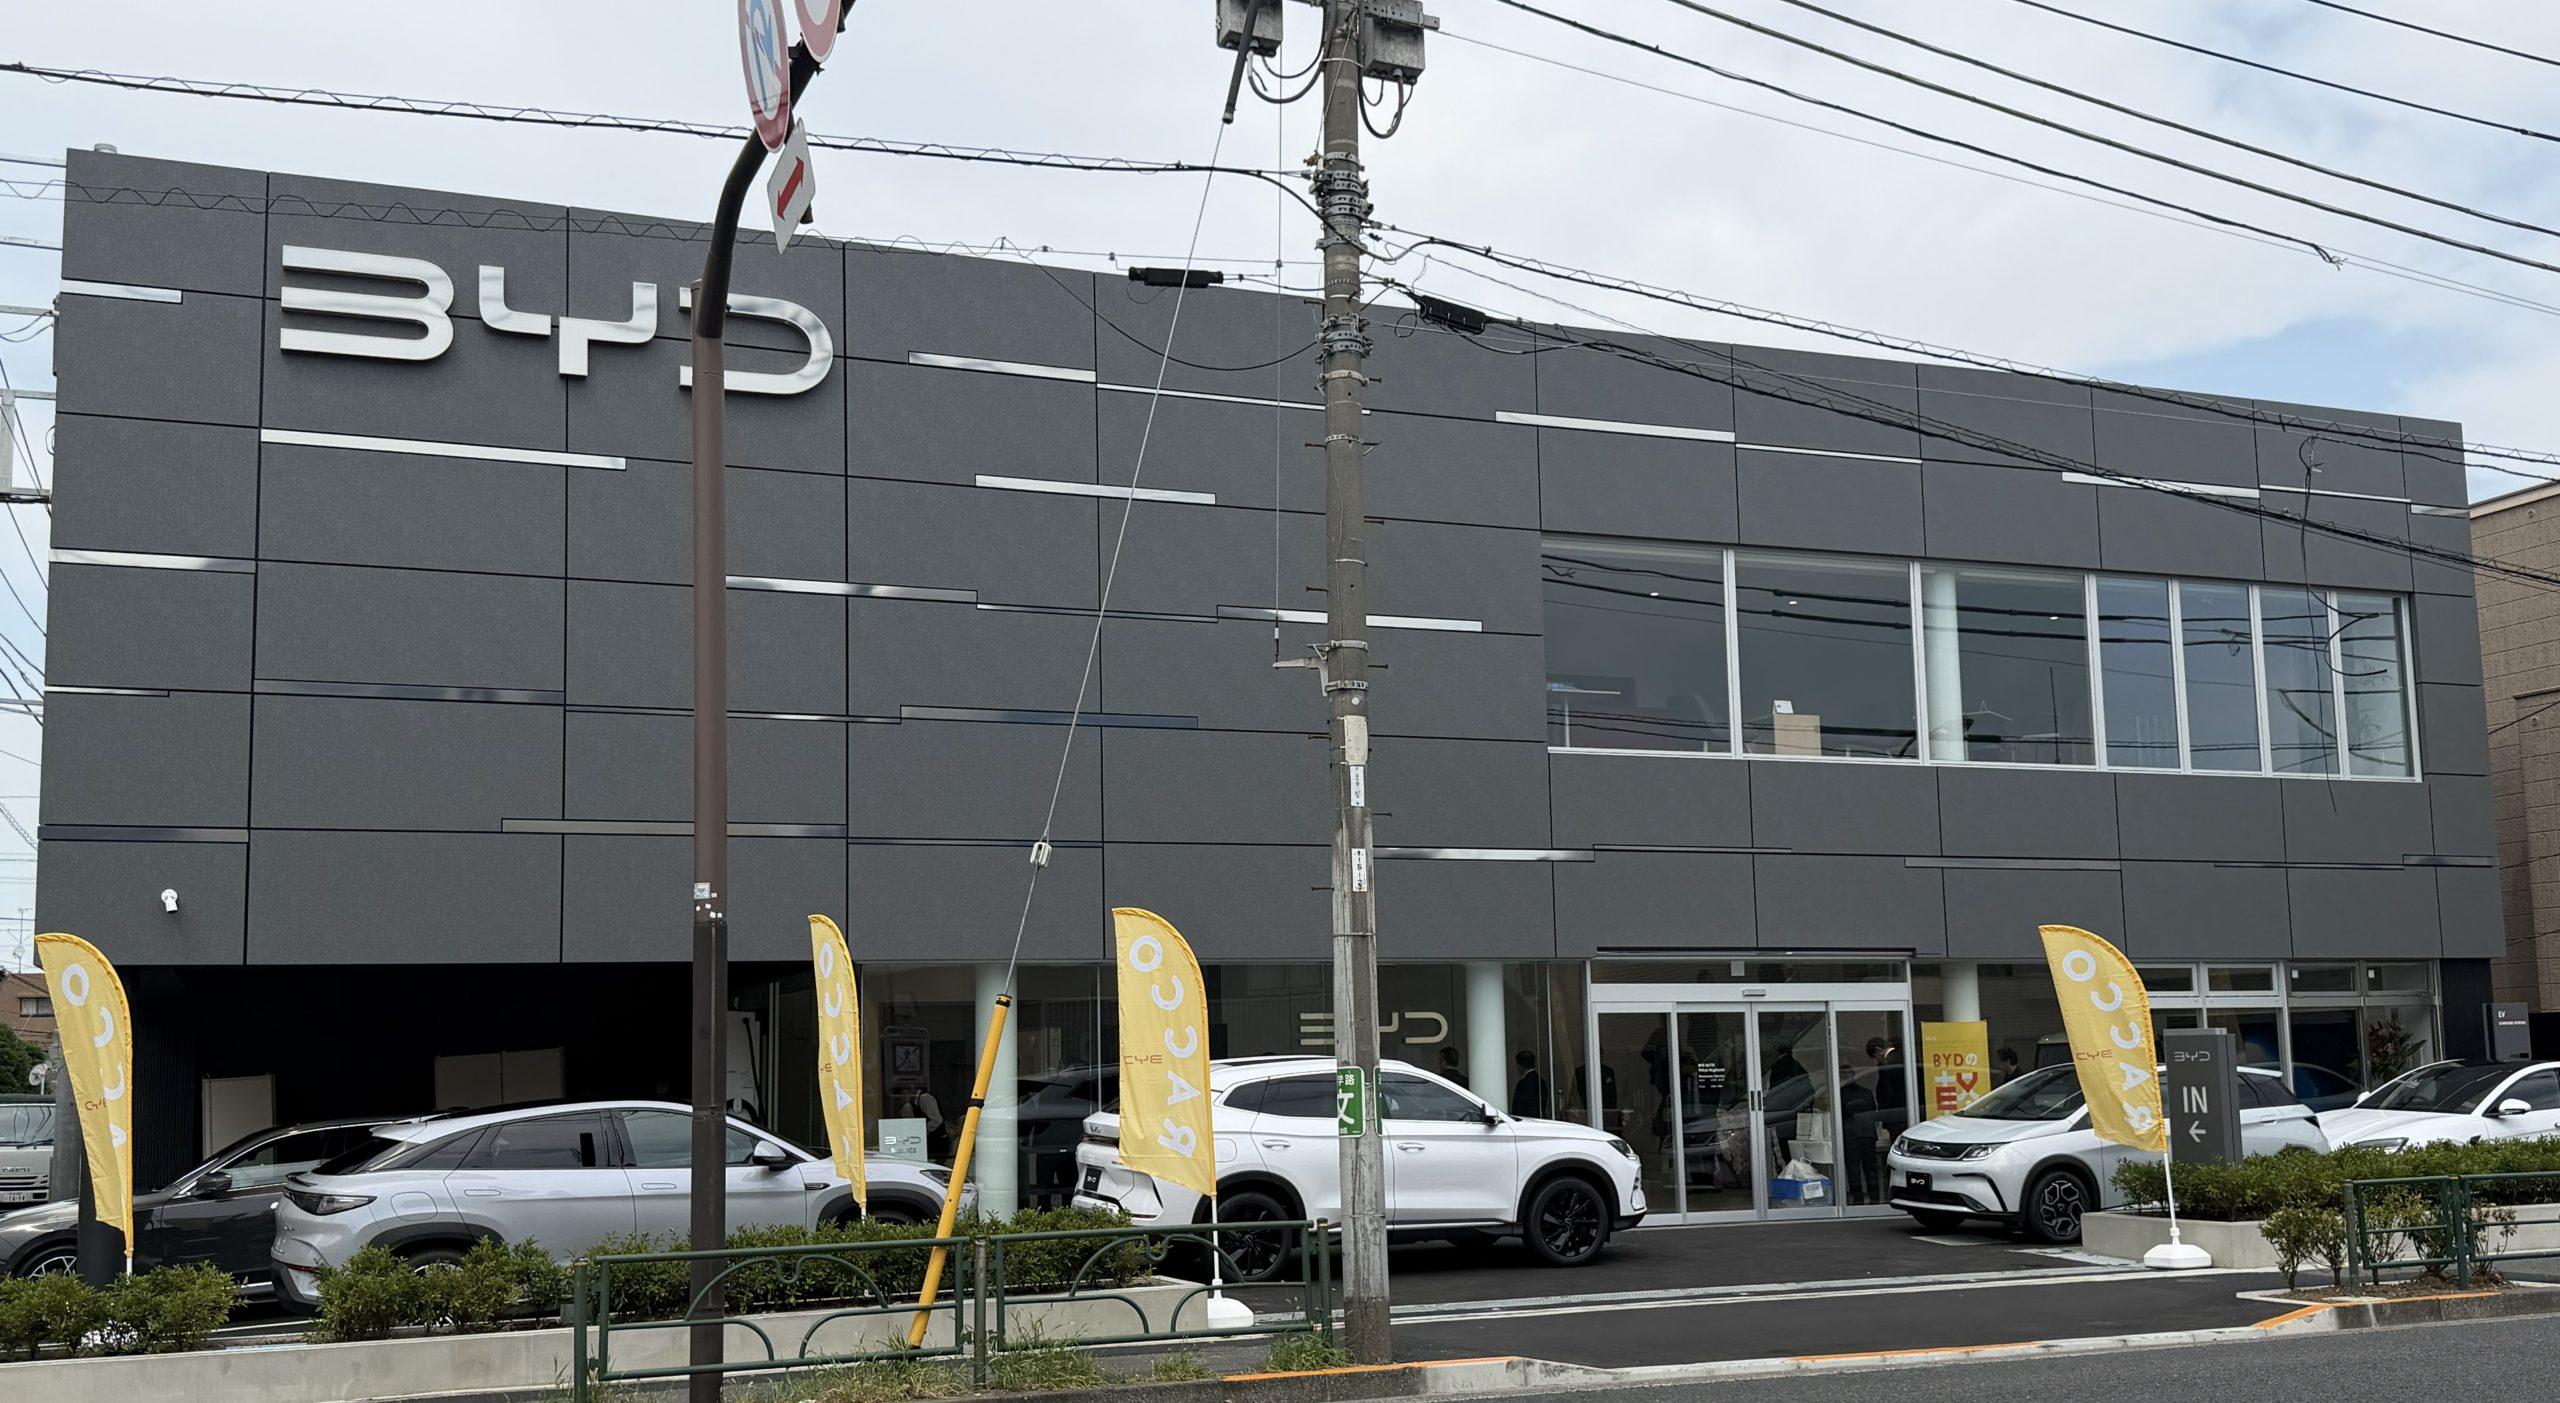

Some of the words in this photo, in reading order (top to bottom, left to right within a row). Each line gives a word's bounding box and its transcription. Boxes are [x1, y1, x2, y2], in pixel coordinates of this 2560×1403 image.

[280, 244, 834, 395] BYD
[1933, 1053, 1977, 1068] BYDの
[2173, 1051, 2211, 1062] BYD
[1337, 1088, 1355, 1124] 文
[2182, 1086, 2208, 1114] IN
